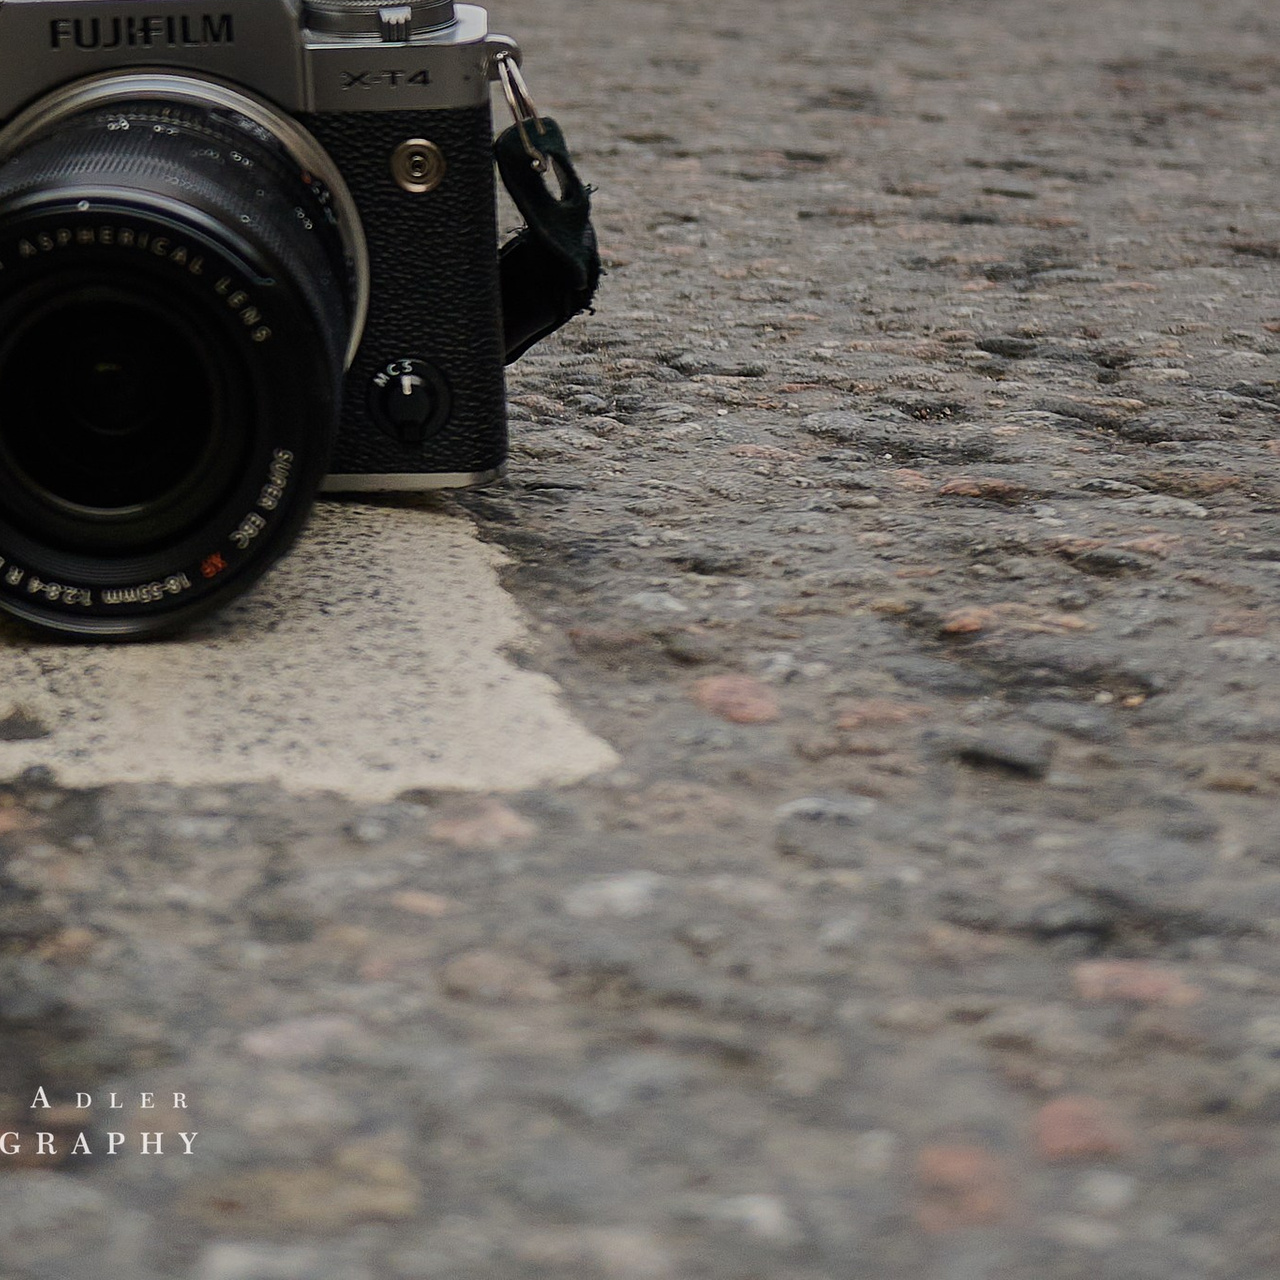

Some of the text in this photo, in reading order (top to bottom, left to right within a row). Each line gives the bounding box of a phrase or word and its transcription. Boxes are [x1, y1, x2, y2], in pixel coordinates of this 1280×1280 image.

[50, 14, 235, 51] FUJIFILM
[340, 69, 432, 90] X-T4
[17, 225, 205, 276] ASPHERICAL
[214, 276, 273, 343] LENS
[257, 448, 293, 511] SUPER
[227, 511, 268, 550] EBC
[8, 564, 25, 585] R
[27, 574, 93, 608] 1:2.8-4
[101, 572, 192, 606] 18-55mm
